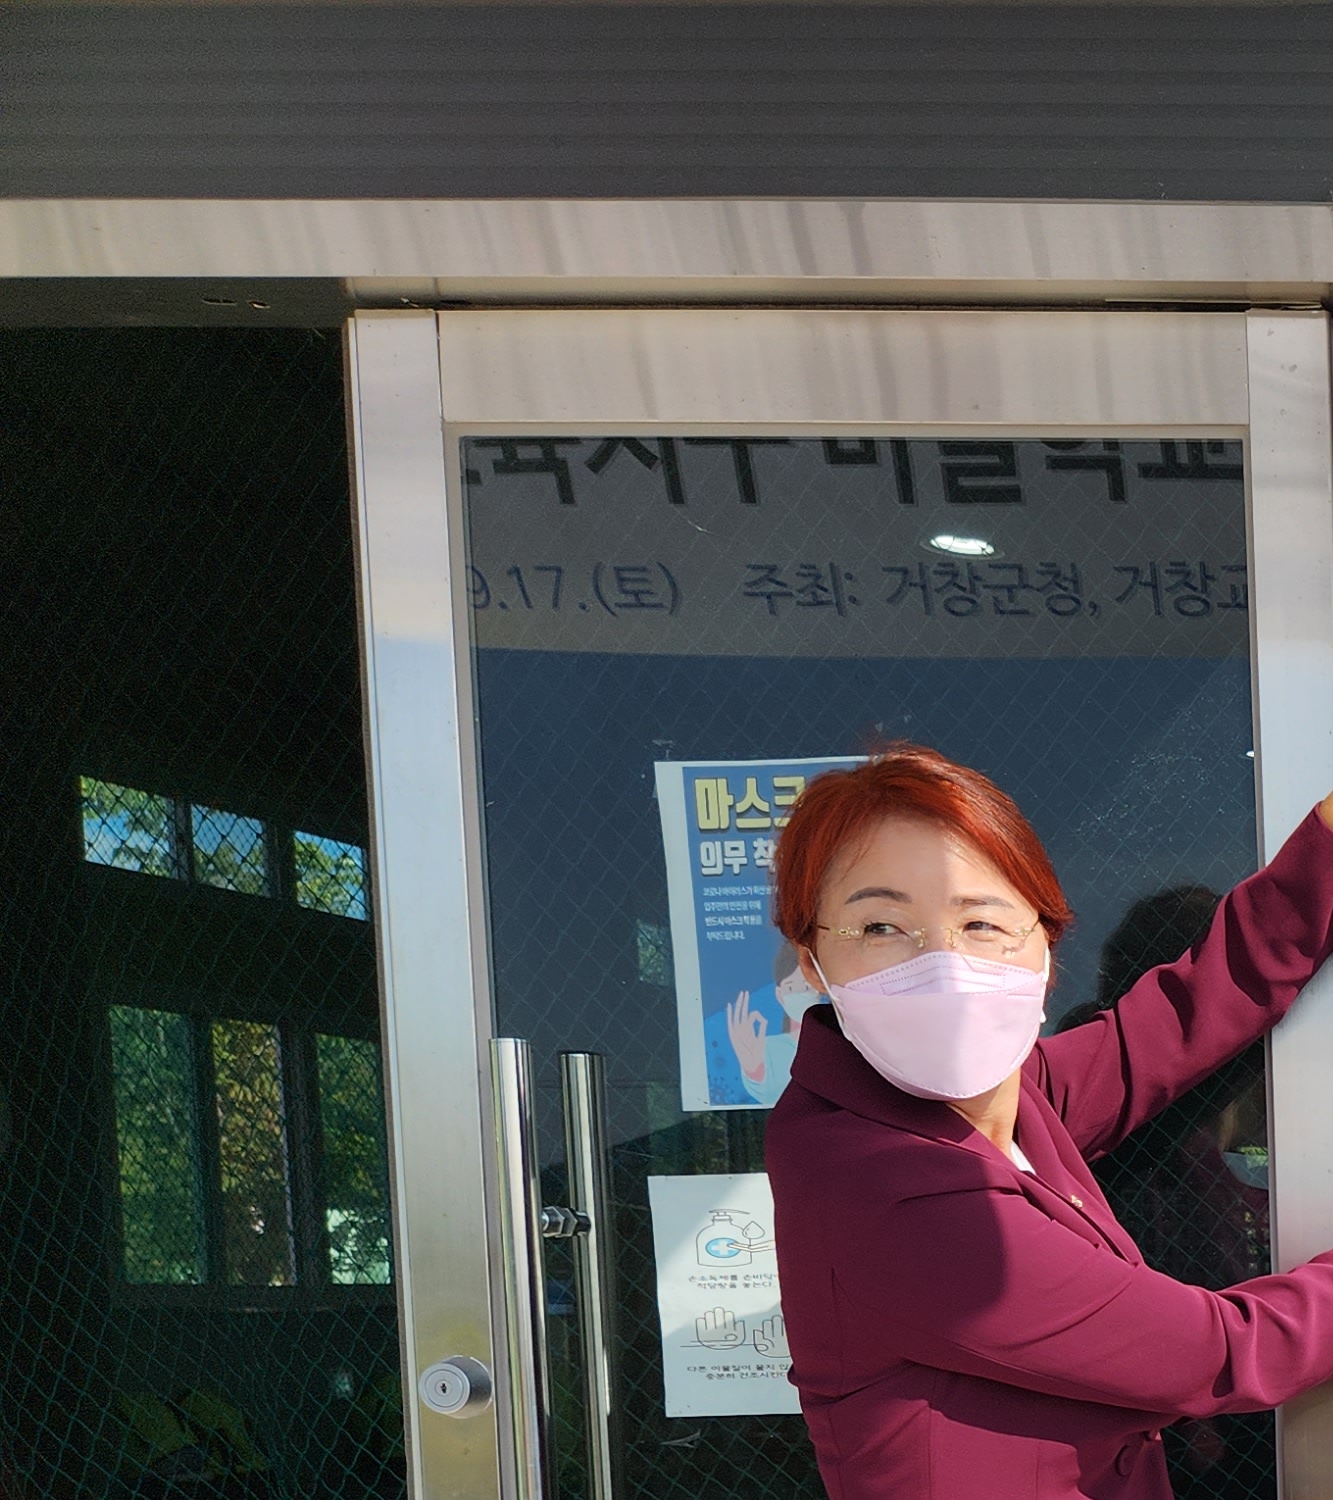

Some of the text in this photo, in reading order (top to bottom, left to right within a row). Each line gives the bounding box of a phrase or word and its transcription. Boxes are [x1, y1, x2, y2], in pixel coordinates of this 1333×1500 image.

[744, 561, 858, 617] 주최:
[882, 560, 1098, 617] 거창군청,
[700, 839, 748, 876] 의무
[743, 1273, 778, 1281] 손바닥
